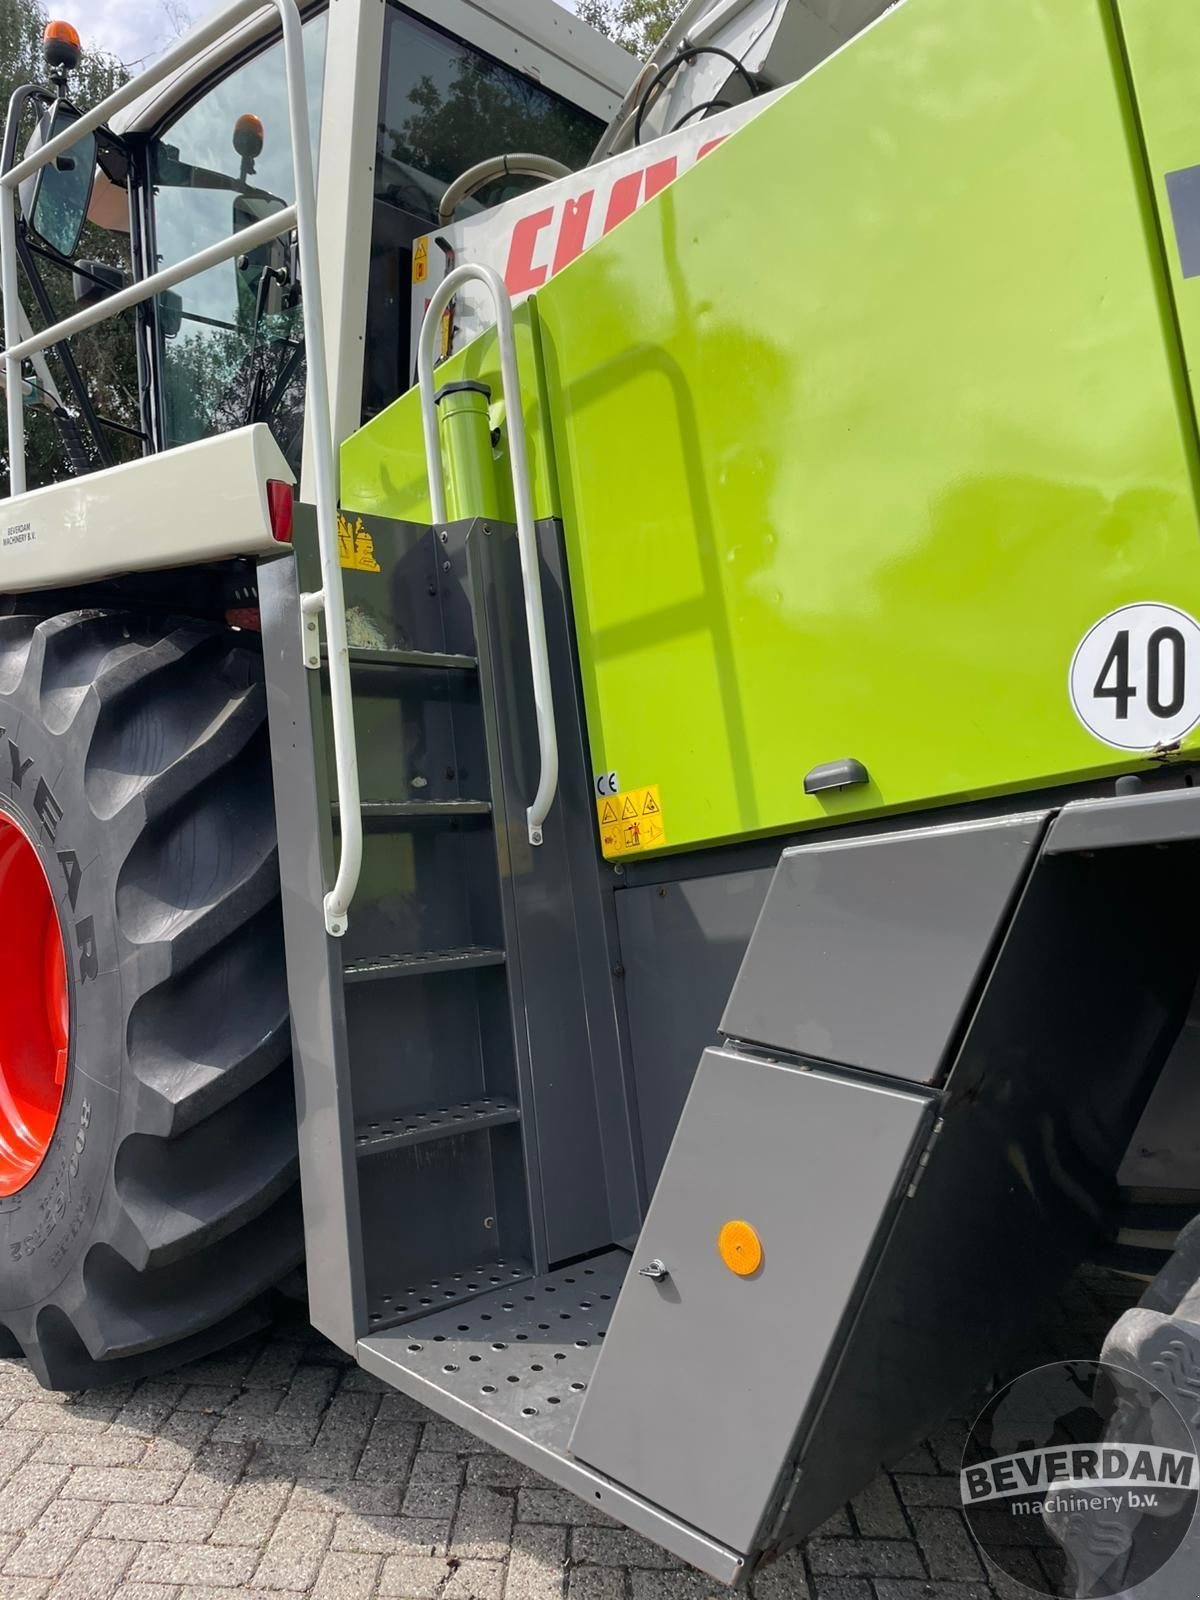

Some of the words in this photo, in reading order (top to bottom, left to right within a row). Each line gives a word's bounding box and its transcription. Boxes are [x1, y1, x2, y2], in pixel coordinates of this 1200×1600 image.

[1093, 626, 1186, 719] 40
[597, 773, 617, 795] CE
[0, 726, 98, 984] YEAR
